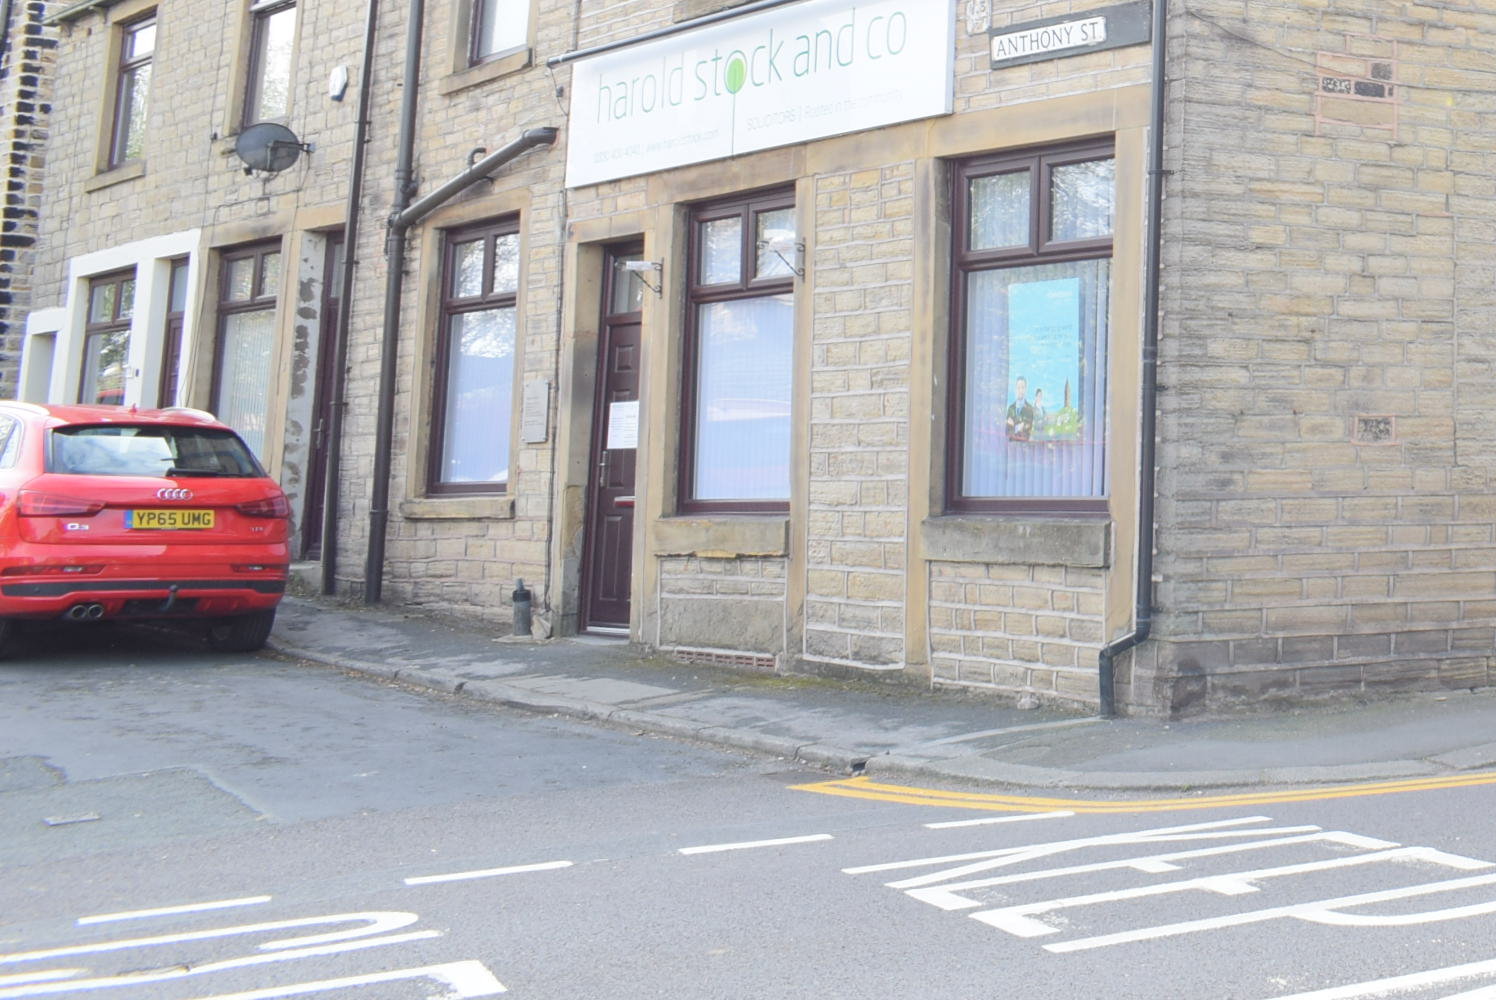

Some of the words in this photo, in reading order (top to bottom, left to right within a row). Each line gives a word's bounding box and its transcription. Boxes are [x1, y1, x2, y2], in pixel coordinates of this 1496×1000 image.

[996, 26, 1073, 57] ANTHONY
[595, 50, 685, 125] harold
[693, 26, 785, 102] stock
[792, 6, 857, 78] and
[865, 10, 908, 61] co
[136, 512, 177, 526] YP65
[181, 511, 212, 526] UMG
